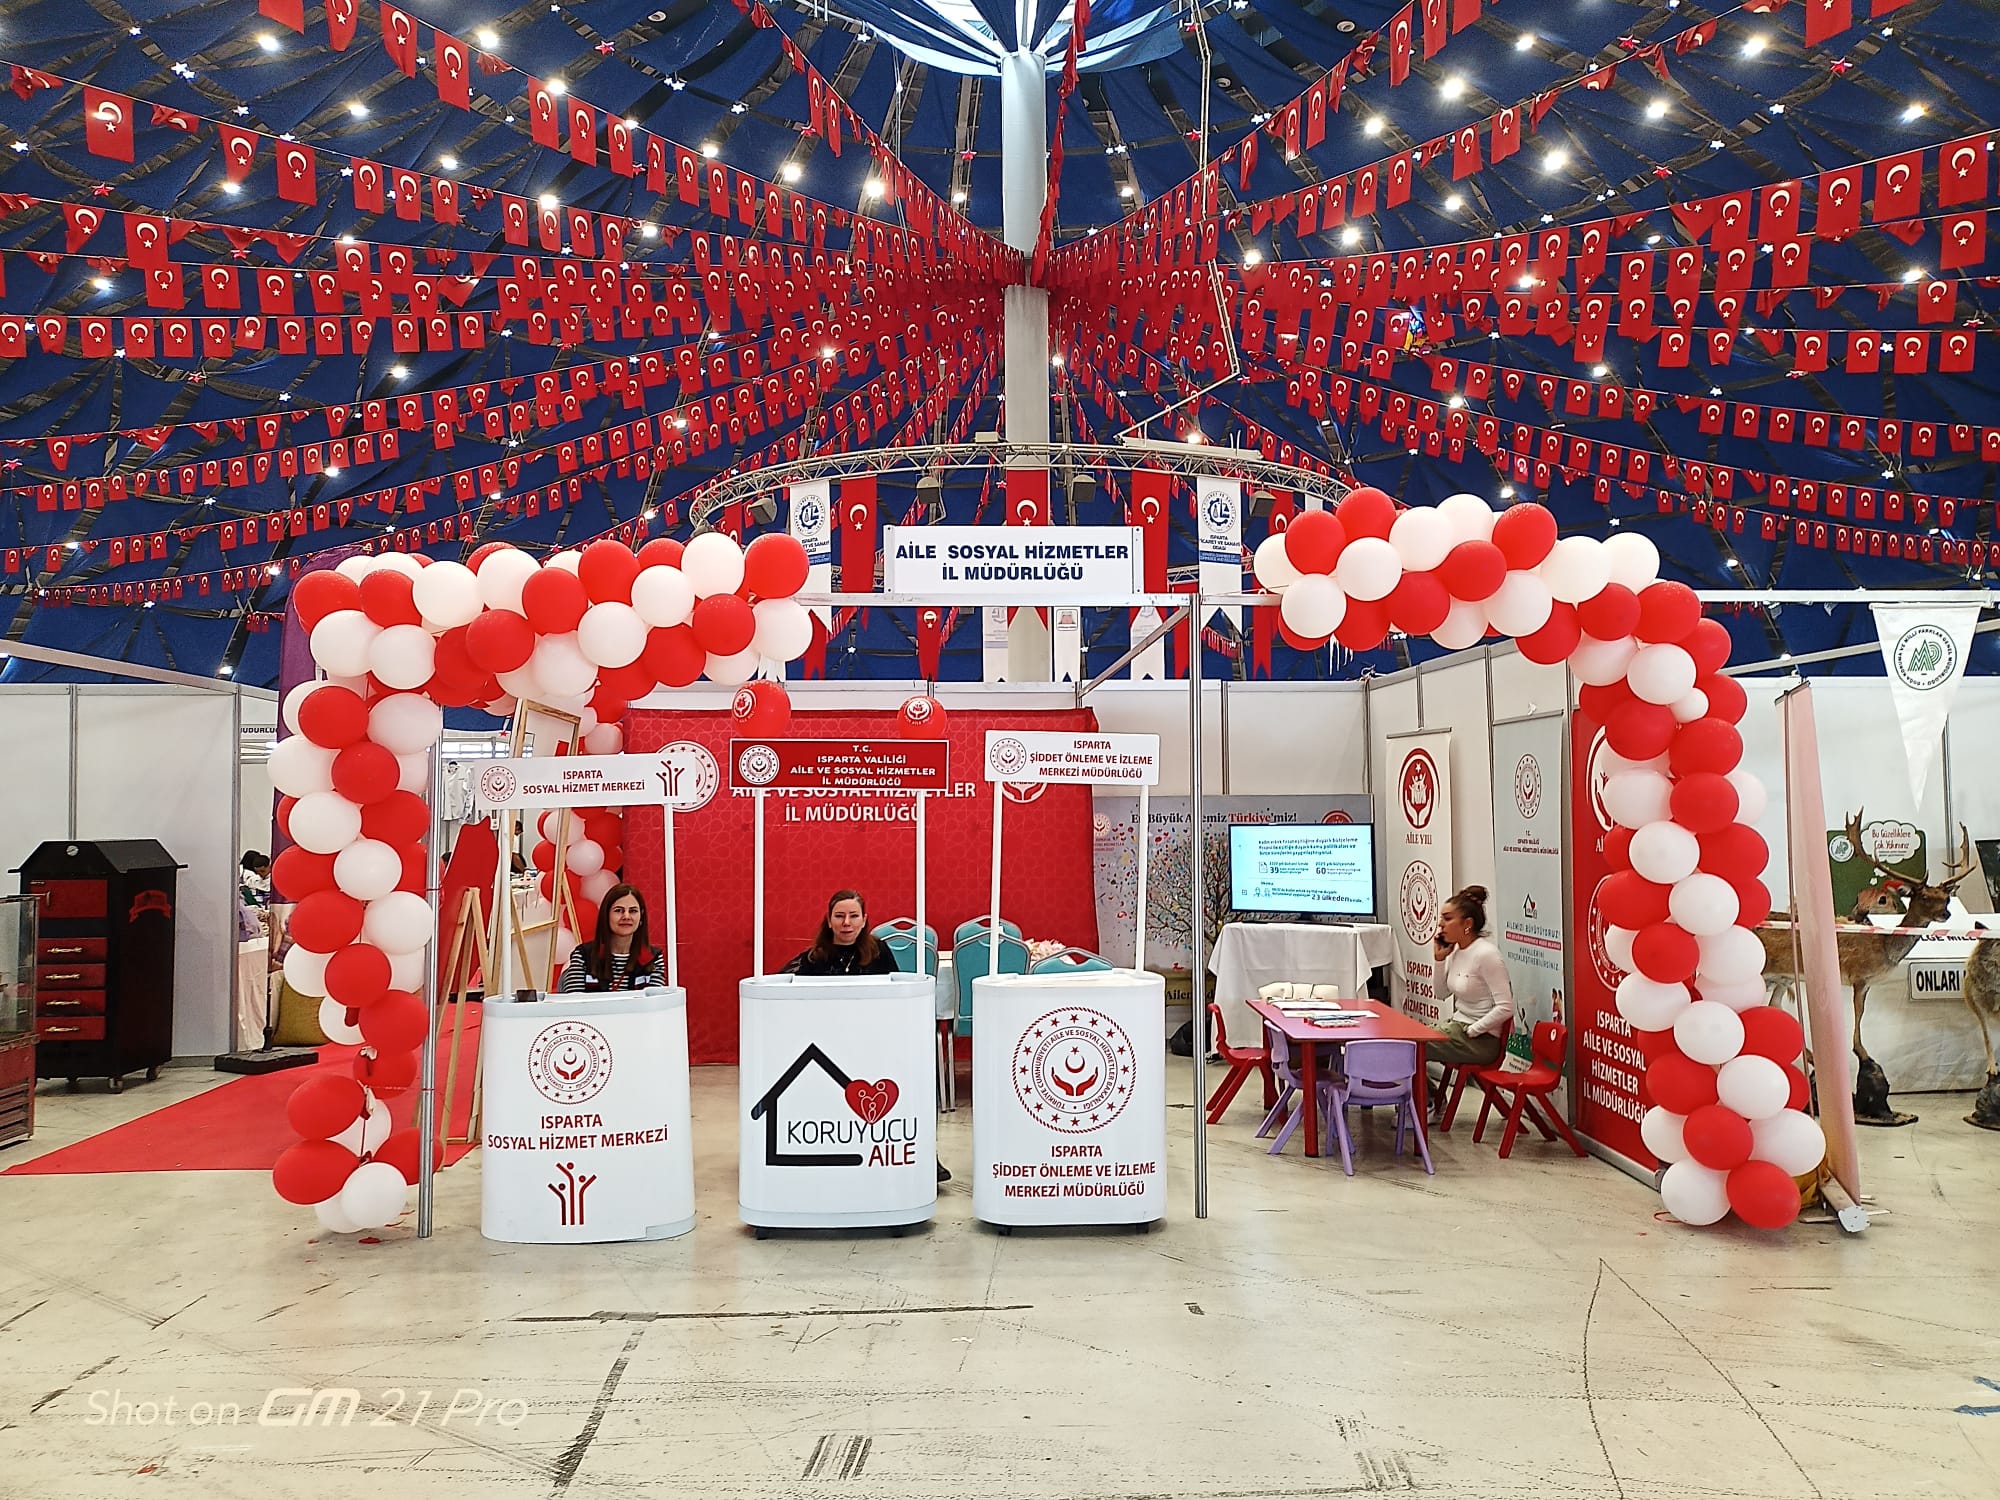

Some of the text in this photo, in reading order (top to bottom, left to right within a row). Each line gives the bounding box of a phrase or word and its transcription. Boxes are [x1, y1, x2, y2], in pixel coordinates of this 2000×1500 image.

[896, 541, 1128, 559] AİLE SOSYAL HİZMETLER
[942, 563, 1083, 580] İL MÜDÜRLÜĞÜ
[852, 745, 872, 753] T.C.
[1074, 740, 1111, 750] ISPARTA
[817, 754, 906, 764] ISPARTA VALİLİĞİ
[1029, 752, 1153, 765] ŞİDDET ÖNLEME VE İZLEME
[563, 769, 604, 780] ISPARTA
[790, 765, 936, 776] AİLE VE SOSYAL HİZMETLER
[1039, 766, 1143, 779] MERKEZİ MÜDÜRLÜĞÜ
[522, 779, 645, 795] SOSYAL HİZMET MERKEZİ
[822, 777, 901, 786] İL MÜDÜRLÜĞÜ
[785, 803, 801, 822] İL
[1147, 812, 1183, 826] Büyük
[1405, 832, 1419, 845] AİLE
[1315, 867, 1326, 875] 60
[1406, 960, 1433, 977] ISPARTA
[1916, 970, 1960, 992] ONLARI
[1410, 983, 1420, 996] VE
[1596, 1009, 1632, 1038] ISPARTA
[1050, 1032, 1065, 1044] AİLE
[1075, 1029, 1100, 1045] SOSYAL
[1583, 1029, 1647, 1071] AİLE VE SOSYAL
[1591, 1058, 1639, 1095] HİZMETLER
[1583, 1077, 1592, 1099] İL
[541, 1114, 603, 1129] ISPARTA
[488, 1124, 668, 1150] SOSYAL HİZMET MERKEZİ
[788, 1117, 917, 1144] KORUYUCU
[868, 1139, 916, 1167] AİLE
[1051, 1145, 1103, 1158] ISPARTA
[992, 1161, 1156, 1179] ŞİDDET ÖNLEME VE İZLEME
[1005, 1180, 1145, 1198] MERKEZİ MÜDÜRLÜĞÜ
